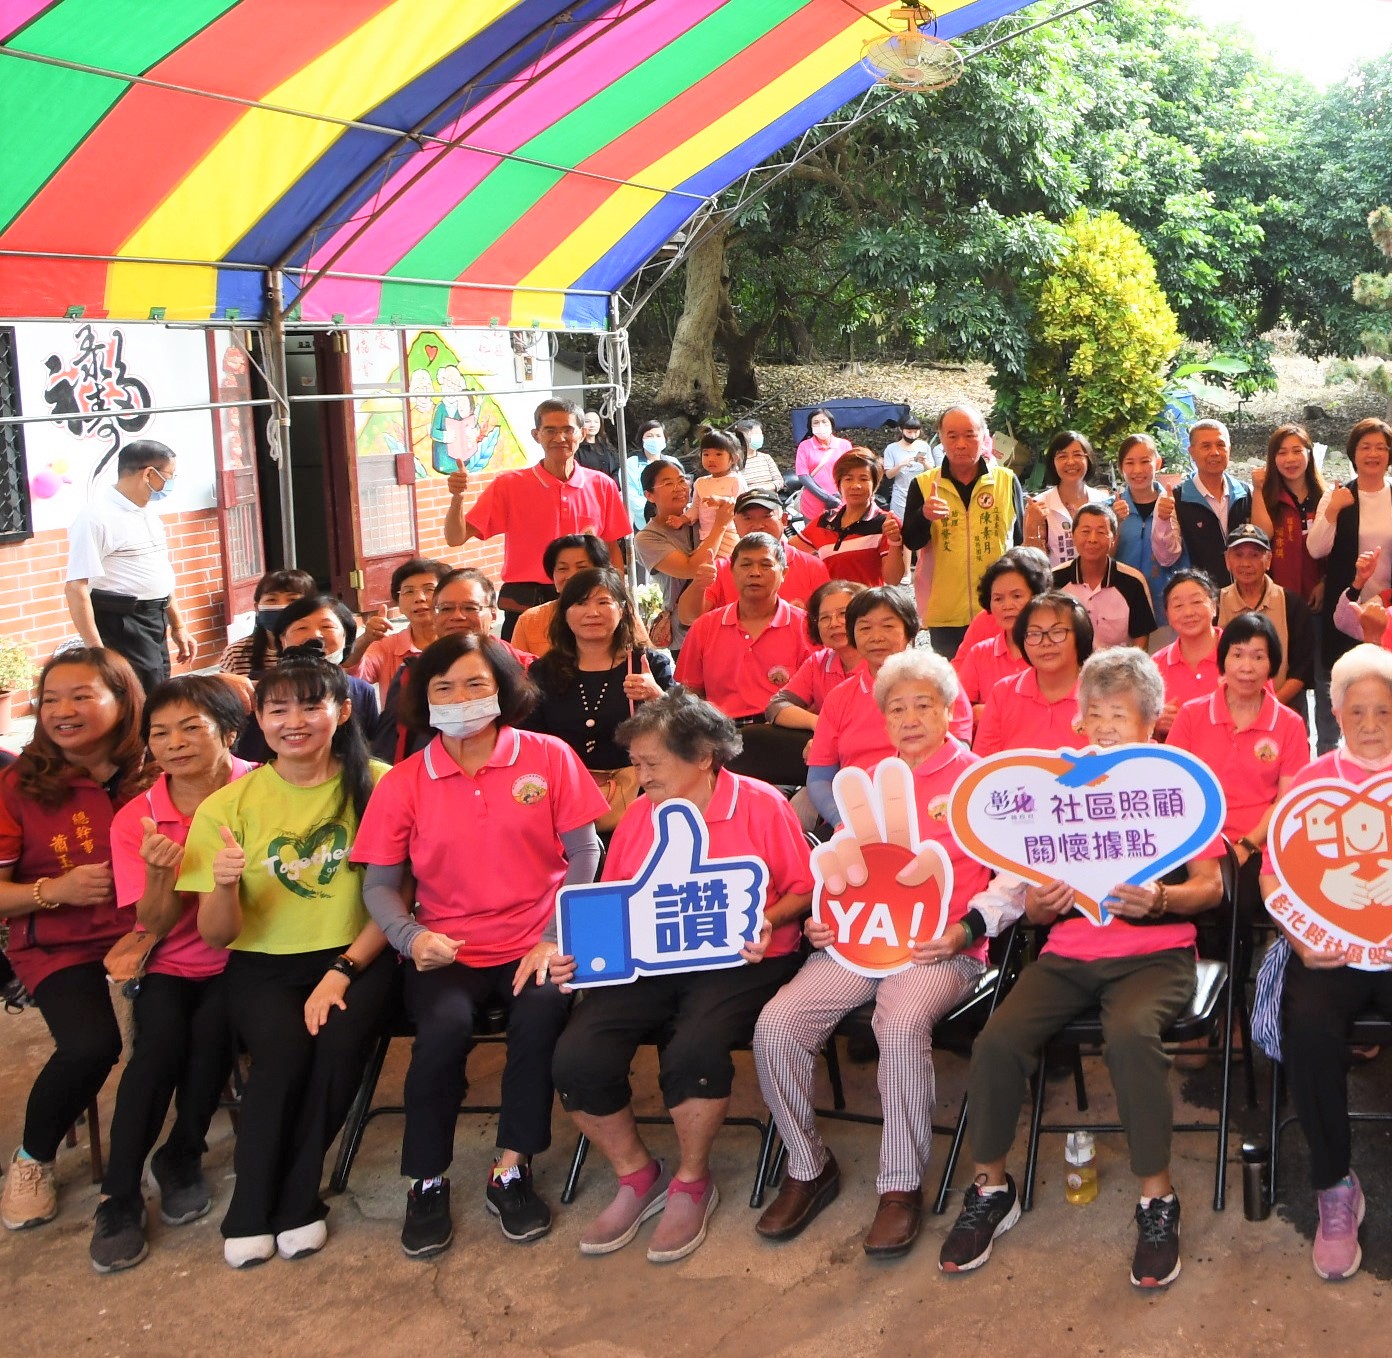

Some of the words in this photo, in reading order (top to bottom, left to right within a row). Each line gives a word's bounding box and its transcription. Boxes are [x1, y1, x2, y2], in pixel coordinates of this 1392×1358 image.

[1050, 788, 1184, 824] 社區照顧
[72, 811, 94, 854] 總幹事
[1024, 829, 1157, 865] 關懷據點
[653, 879, 729, 954] 讚
[826, 900, 925, 949] YA!
